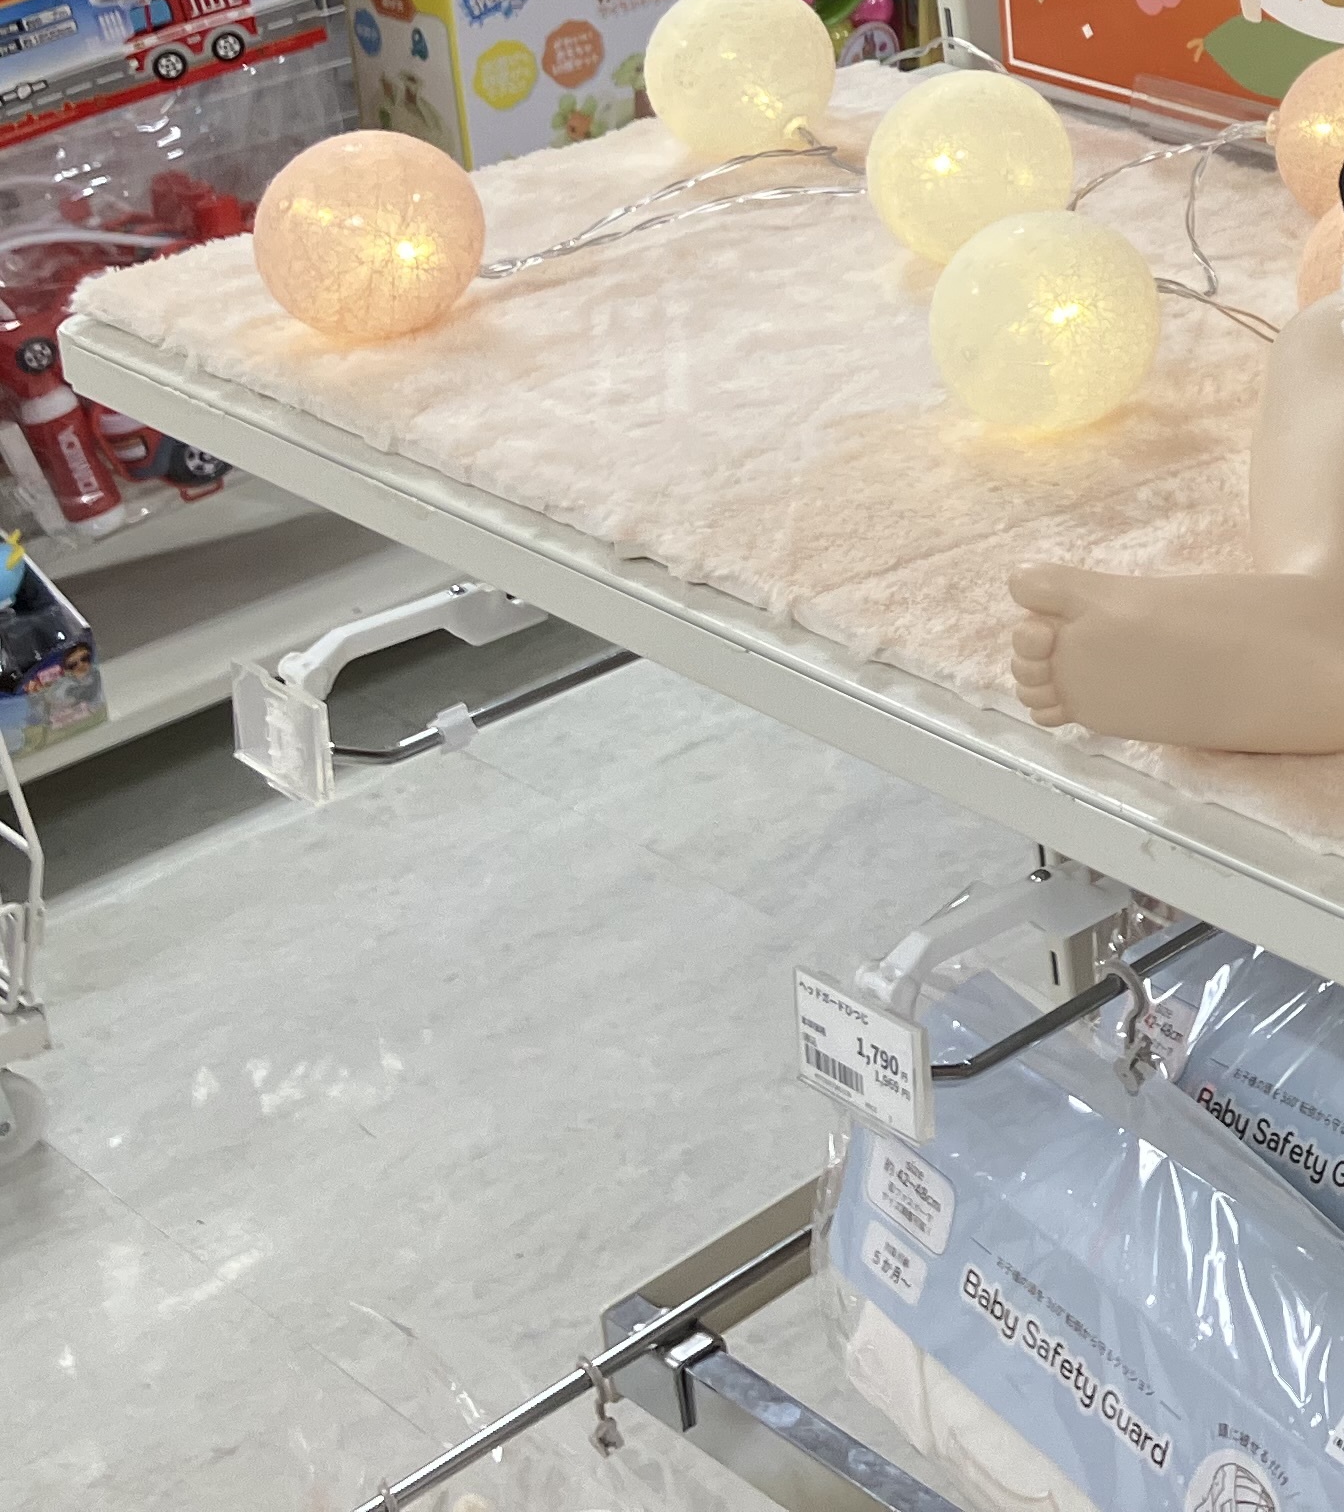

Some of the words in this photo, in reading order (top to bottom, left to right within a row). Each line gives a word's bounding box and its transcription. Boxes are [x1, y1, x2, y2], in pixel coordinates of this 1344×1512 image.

[856, 1036, 899, 1076] 1,790
[1252, 1118, 1328, 1185] Safety
[963, 1268, 1020, 1339] Baby
[1022, 1320, 1098, 1409] Safety
[1101, 1390, 1171, 1468] Guard
